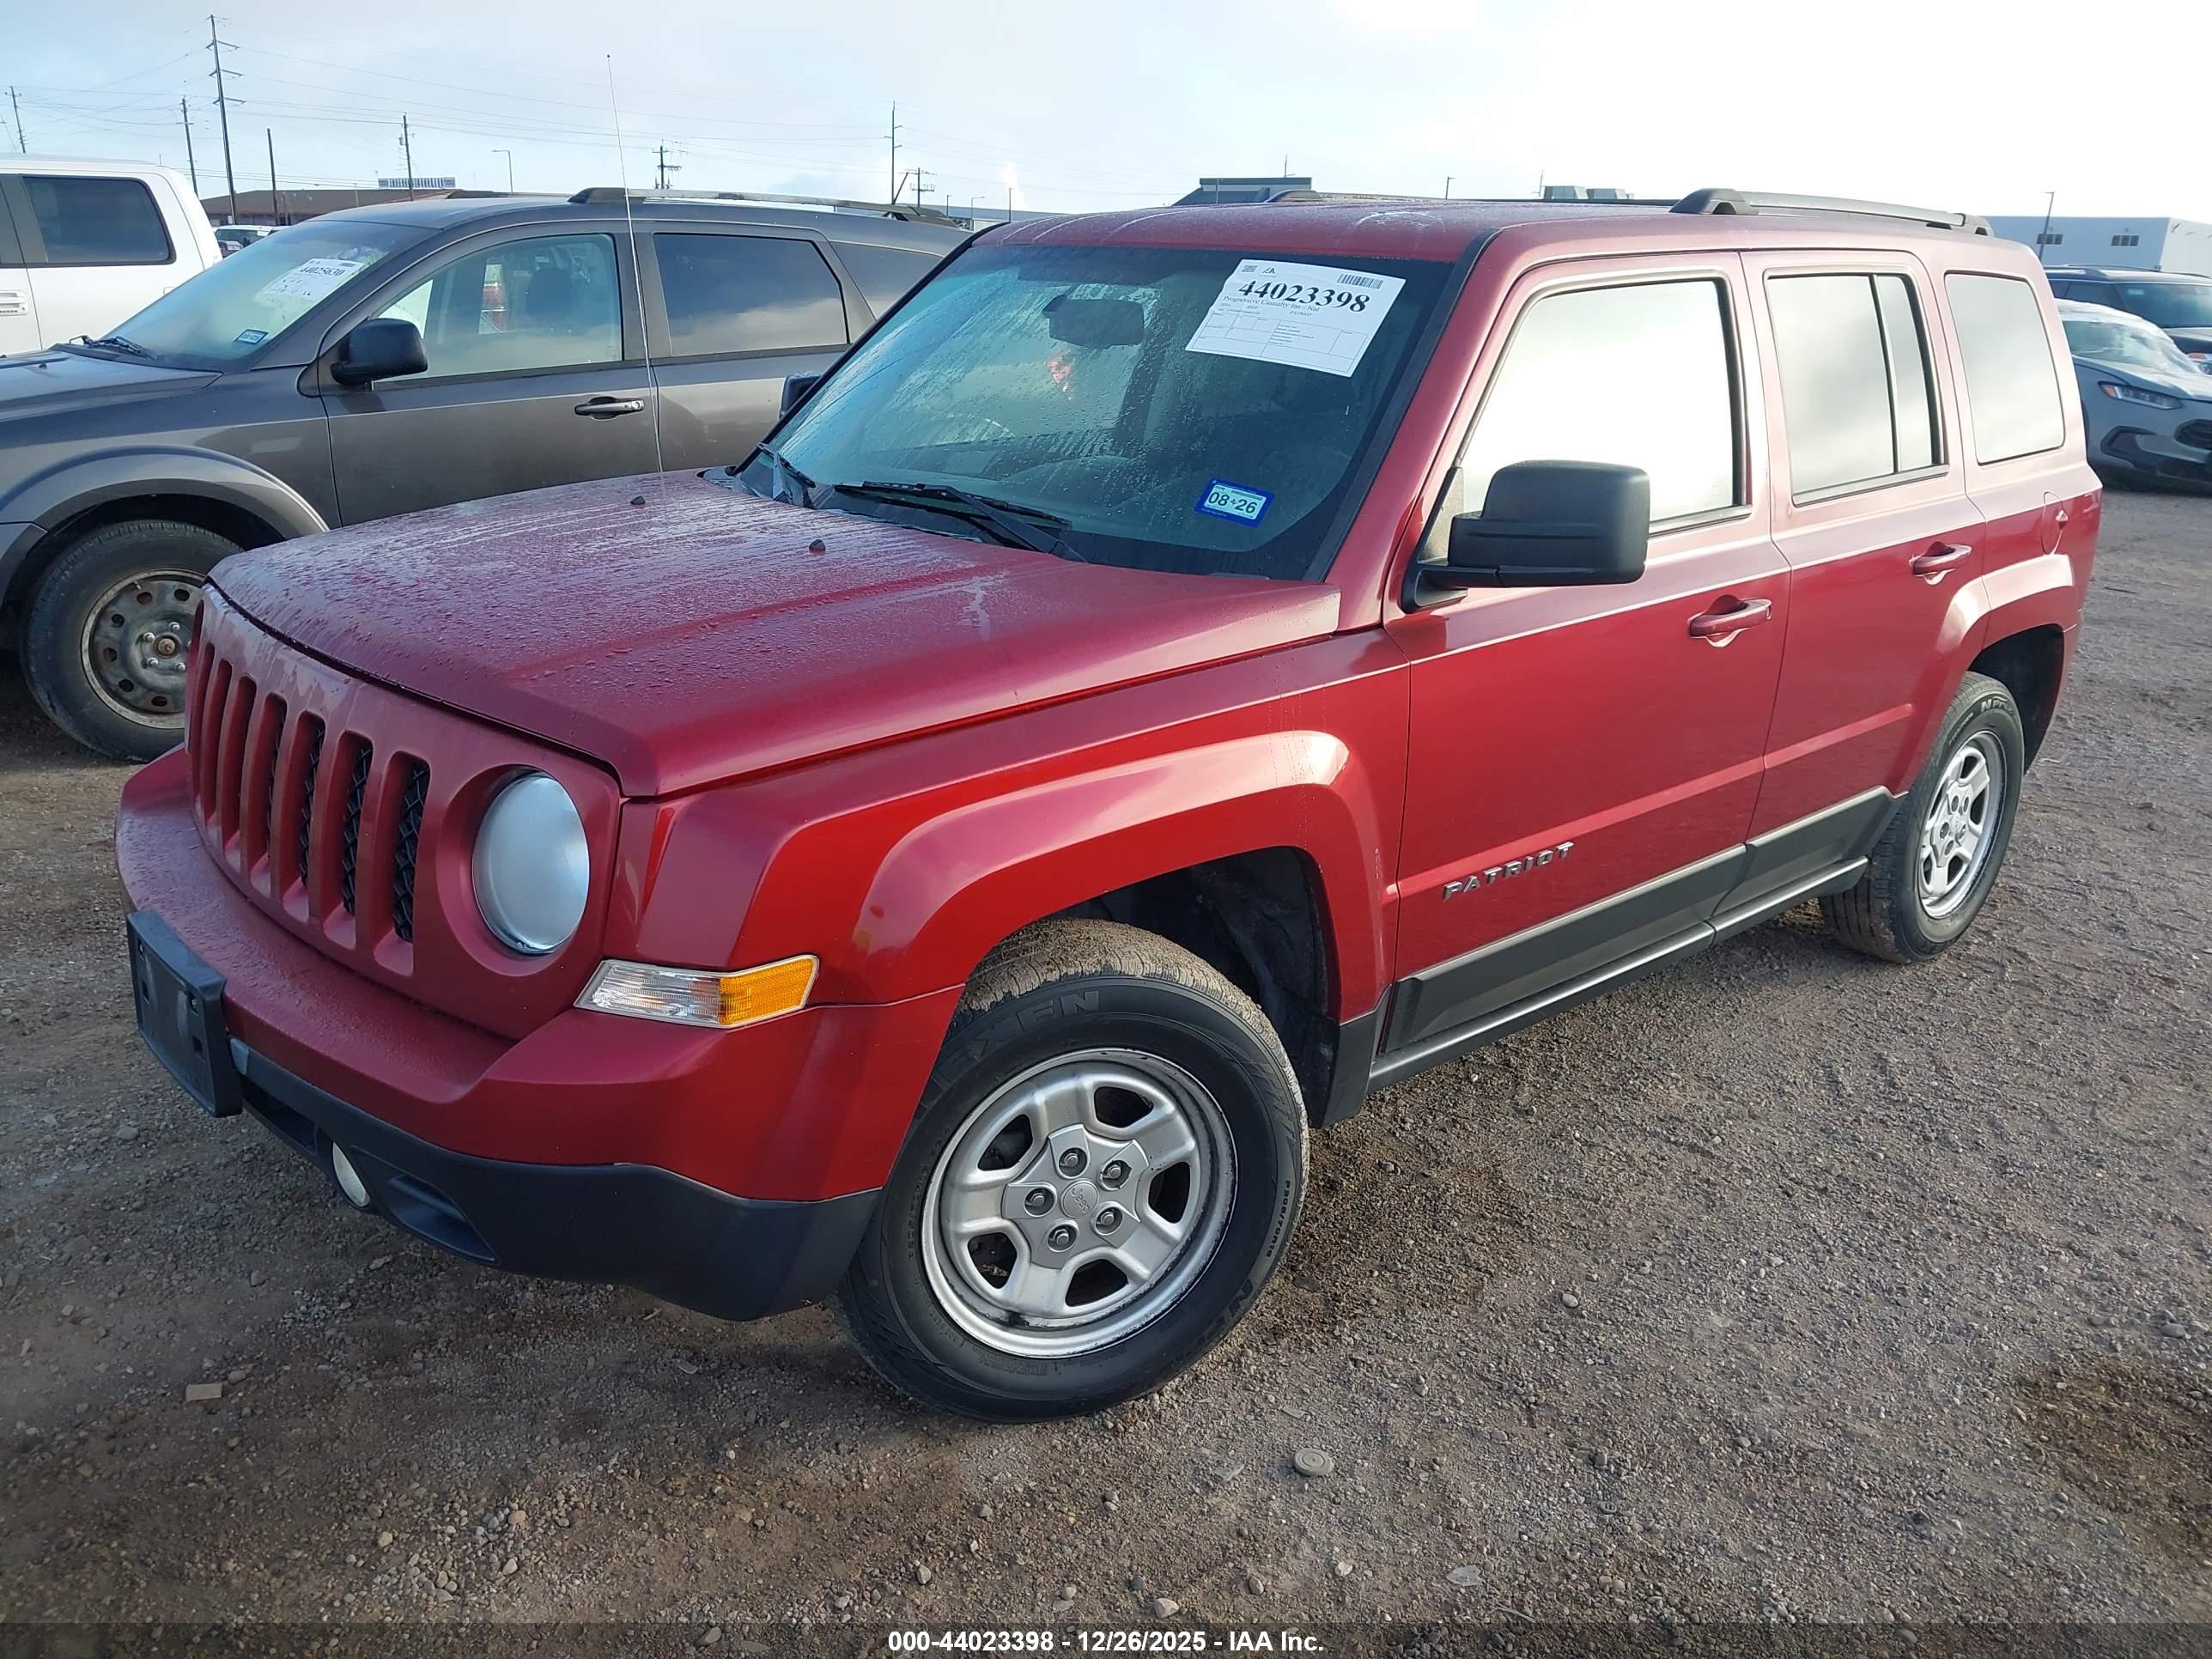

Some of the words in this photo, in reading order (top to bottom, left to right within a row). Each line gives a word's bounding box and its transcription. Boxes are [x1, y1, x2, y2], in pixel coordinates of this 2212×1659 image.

[1223, 295, 1261, 305] Progressive
[1261, 299, 1288, 309] Casualty
[1238, 280, 1370, 313] 44023398
[1443, 841, 1575, 901] PATRIOT
[1070, 1187, 1091, 1214] Jeep
